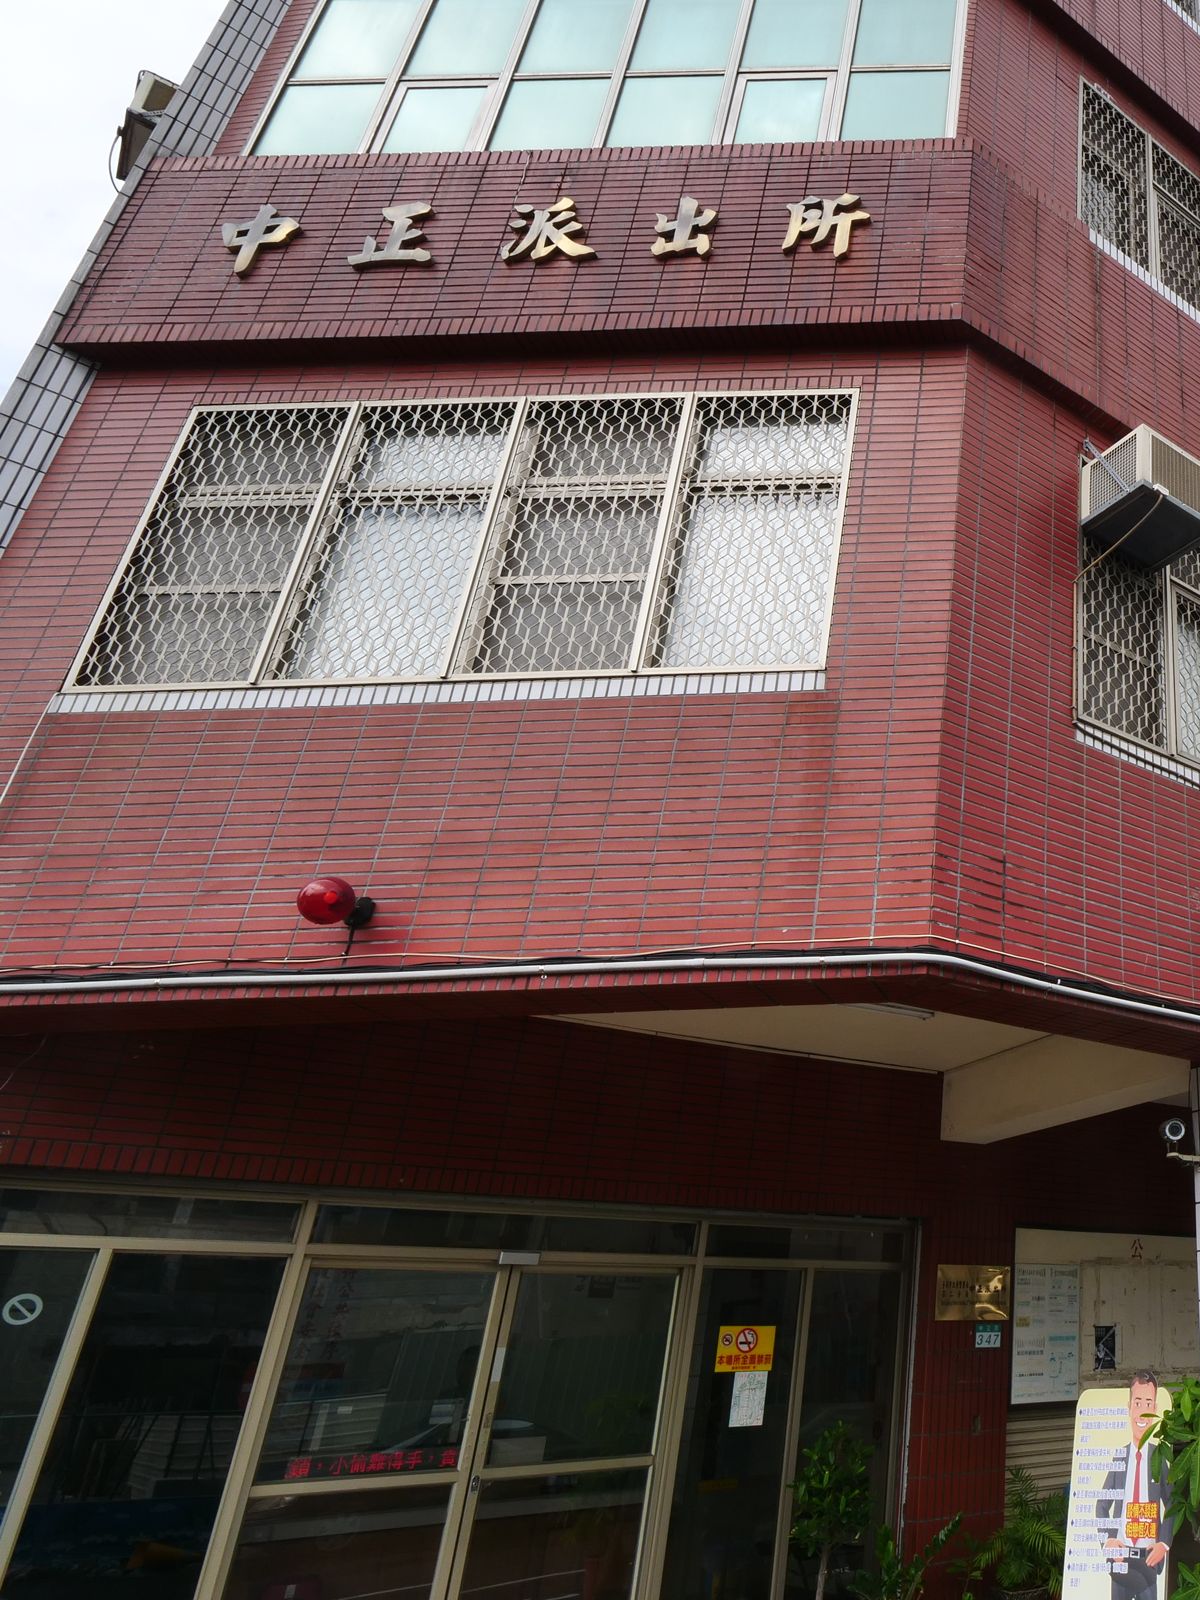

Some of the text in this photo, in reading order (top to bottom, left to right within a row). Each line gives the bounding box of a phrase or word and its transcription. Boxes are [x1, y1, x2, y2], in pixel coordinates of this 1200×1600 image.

[220, 192, 872, 278] 中正派出所
[976, 1334, 999, 1346] 347
